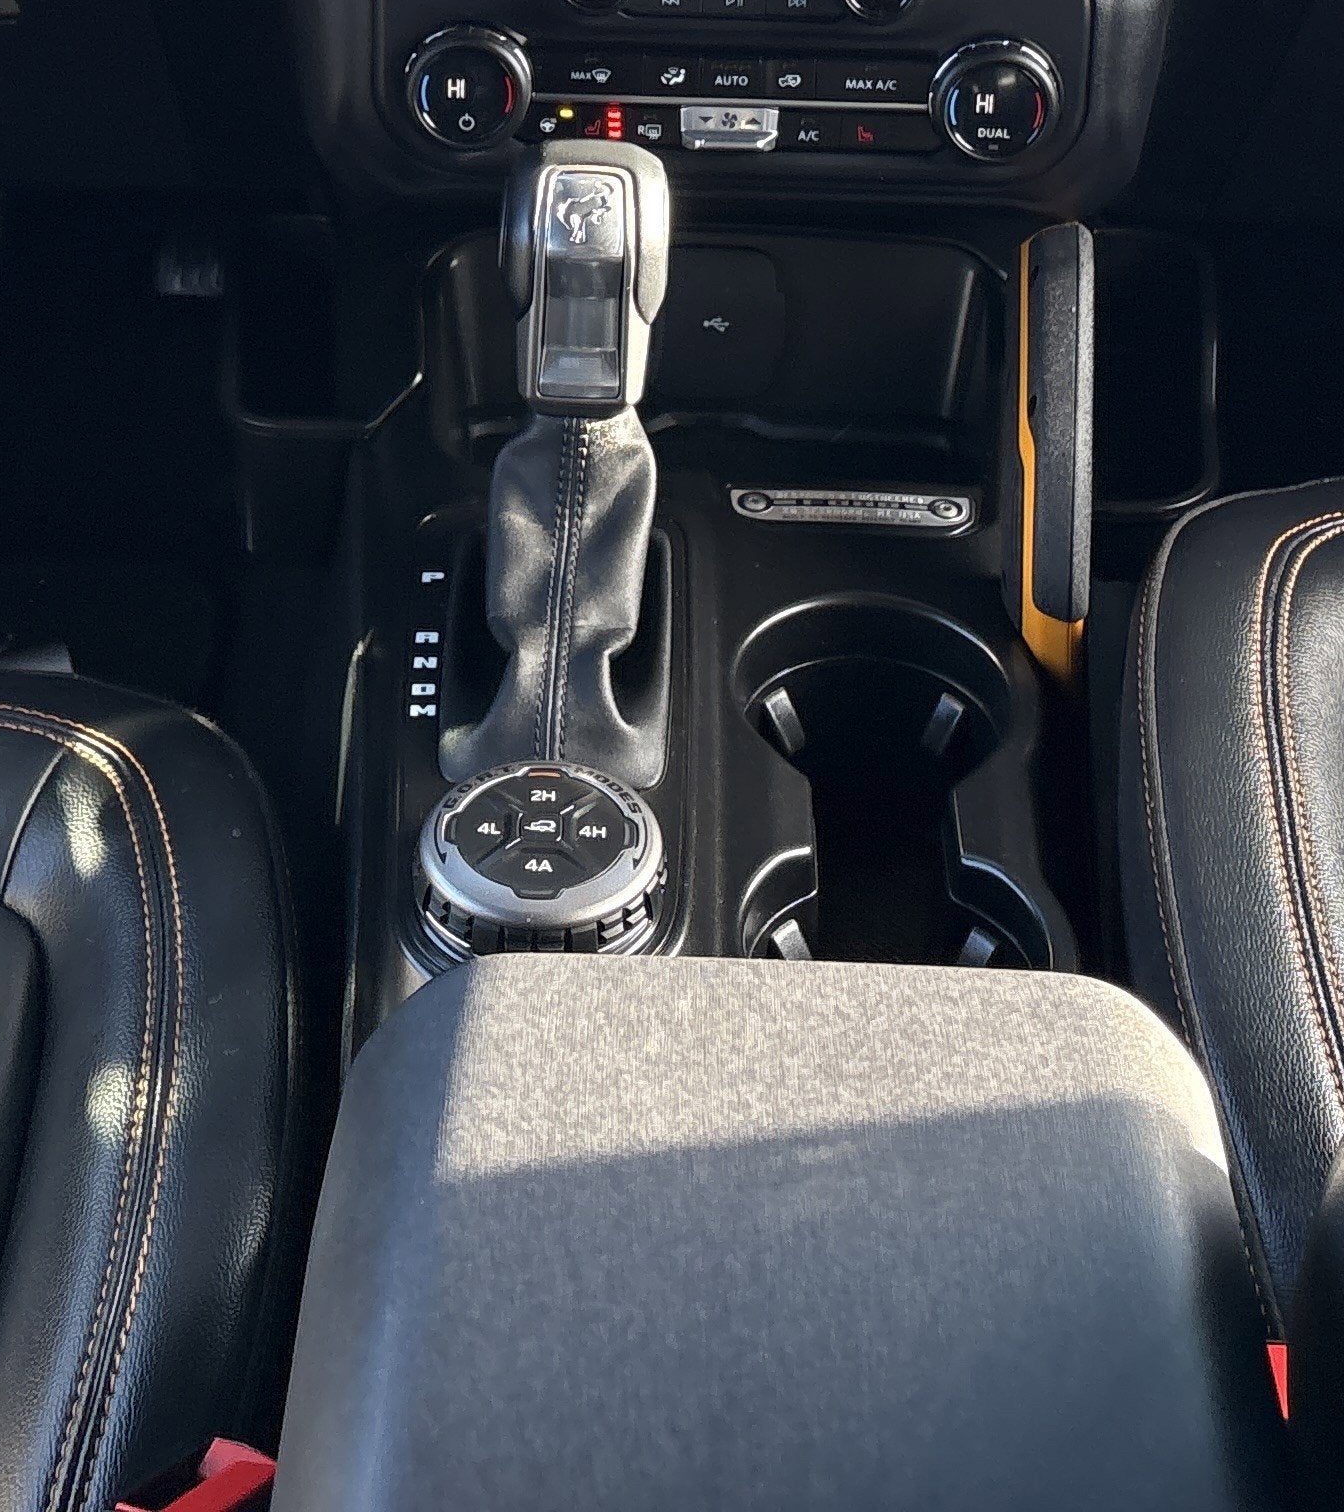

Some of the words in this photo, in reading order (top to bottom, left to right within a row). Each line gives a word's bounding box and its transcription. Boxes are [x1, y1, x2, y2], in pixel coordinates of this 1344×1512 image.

[570, 70, 592, 80] MAX
[714, 74, 748, 87] AUTO
[447, 78, 466, 99] HI
[845, 78, 873, 90] MAX
[875, 79, 897, 91] A/C
[975, 93, 995, 115] HI
[797, 130, 820, 142] A/C
[977, 127, 1011, 139] DUAL
[421, 571, 445, 583] P
[413, 656, 438, 669] N
[409, 704, 437, 717] M
[530, 790, 556, 802] 2H
[477, 823, 501, 835] 4L
[578, 826, 607, 839] 4H
[524, 859, 554, 872] 4A
